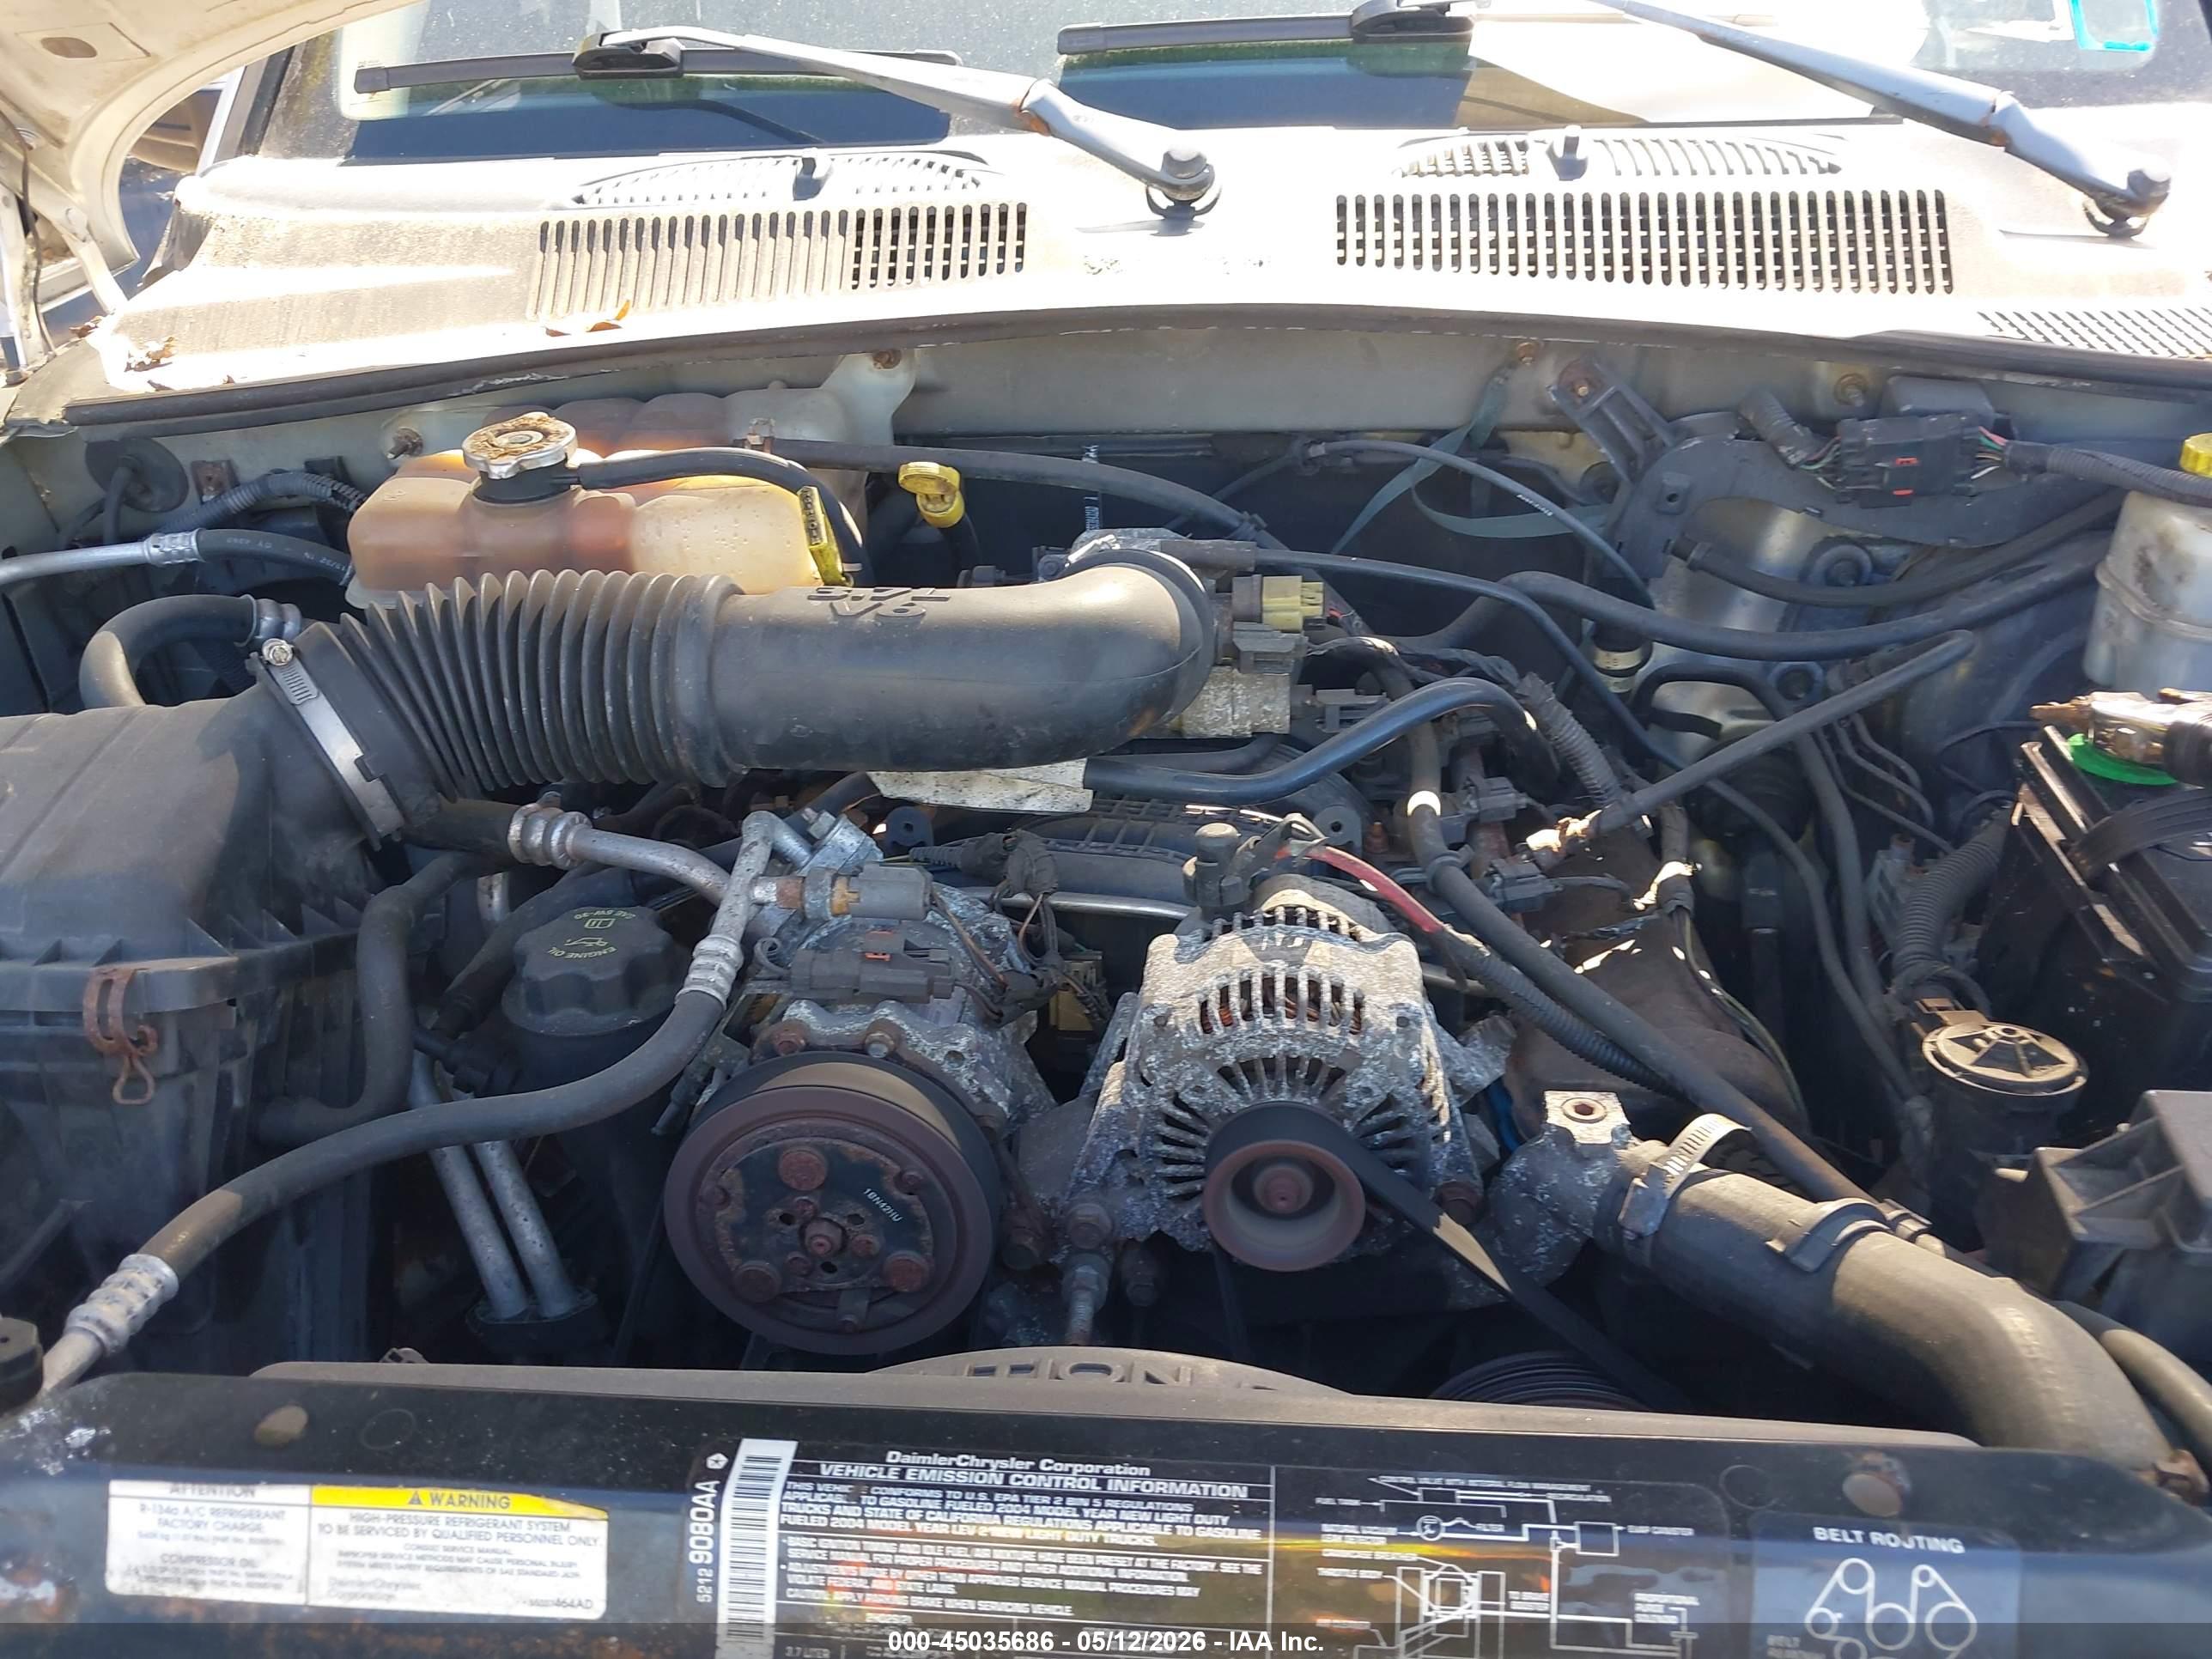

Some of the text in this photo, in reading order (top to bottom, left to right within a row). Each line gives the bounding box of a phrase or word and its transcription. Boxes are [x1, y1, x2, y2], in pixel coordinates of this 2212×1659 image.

[830, 602, 927, 620] V6
[547, 946, 617, 958] ENGINE OIL
[885, 1450, 1151, 1476] DaimlerChrysler Corporation
[169, 1484, 256, 1498] ATTENTION
[819, 1462, 1249, 1498] VEHICLE EMISSION CONTROL INFORMATION
[430, 1492, 511, 1509] WARNING
[787, 1481, 1194, 1511] THIS VEHICE CONFORMS TO U.S. EPA TIER 2 BIN 5 REGULATIONS
[183, 1506, 206, 1516] A/C
[210, 1507, 286, 1520] REFRIGERANT
[349, 1512, 571, 1532] HIGH-PRESSURE REFRIGERANT SYSTEM
[781, 1503, 1261, 1540] TRUCKS AND STATE OF CALIFORNIA REGULATIONS APPLICABLE TO GASOLINE
[860, 1495, 877, 1504] TO
[879, 1496, 942, 1509] GASOLINE
[945, 1500, 994, 1512] FUELED
[996, 1504, 1030, 1514] 2004
[1033, 1504, 1080, 1517] MODEL
[1083, 1508, 1116, 1519] YEAR
[1119, 1510, 1152, 1522] NEW
[1154, 1511, 1192, 1523] LIGHT
[1194, 1514, 1230, 1525] DUTY
[158, 1517, 209, 1530] FACTORY
[318, 1523, 333, 1534] TO
[337, 1524, 350, 1535] BE
[354, 1525, 410, 1538] SERVICED
[413, 1528, 428, 1538] BY
[432, 1528, 492, 1541] QUALIFIED
[495, 1531, 563, 1545] PERSONNEL
[780, 1514, 828, 1527] FUELED
[830, 1516, 864, 1528] 2004
[866, 1519, 912, 1532] MODEL
[915, 1522, 950, 1534] YEAR
[1064, 1530, 1100, 1543] DUTY
[689, 1480, 720, 1603] 5212 9080AA
[1813, 1527, 1966, 1553] BELT ROUTING
